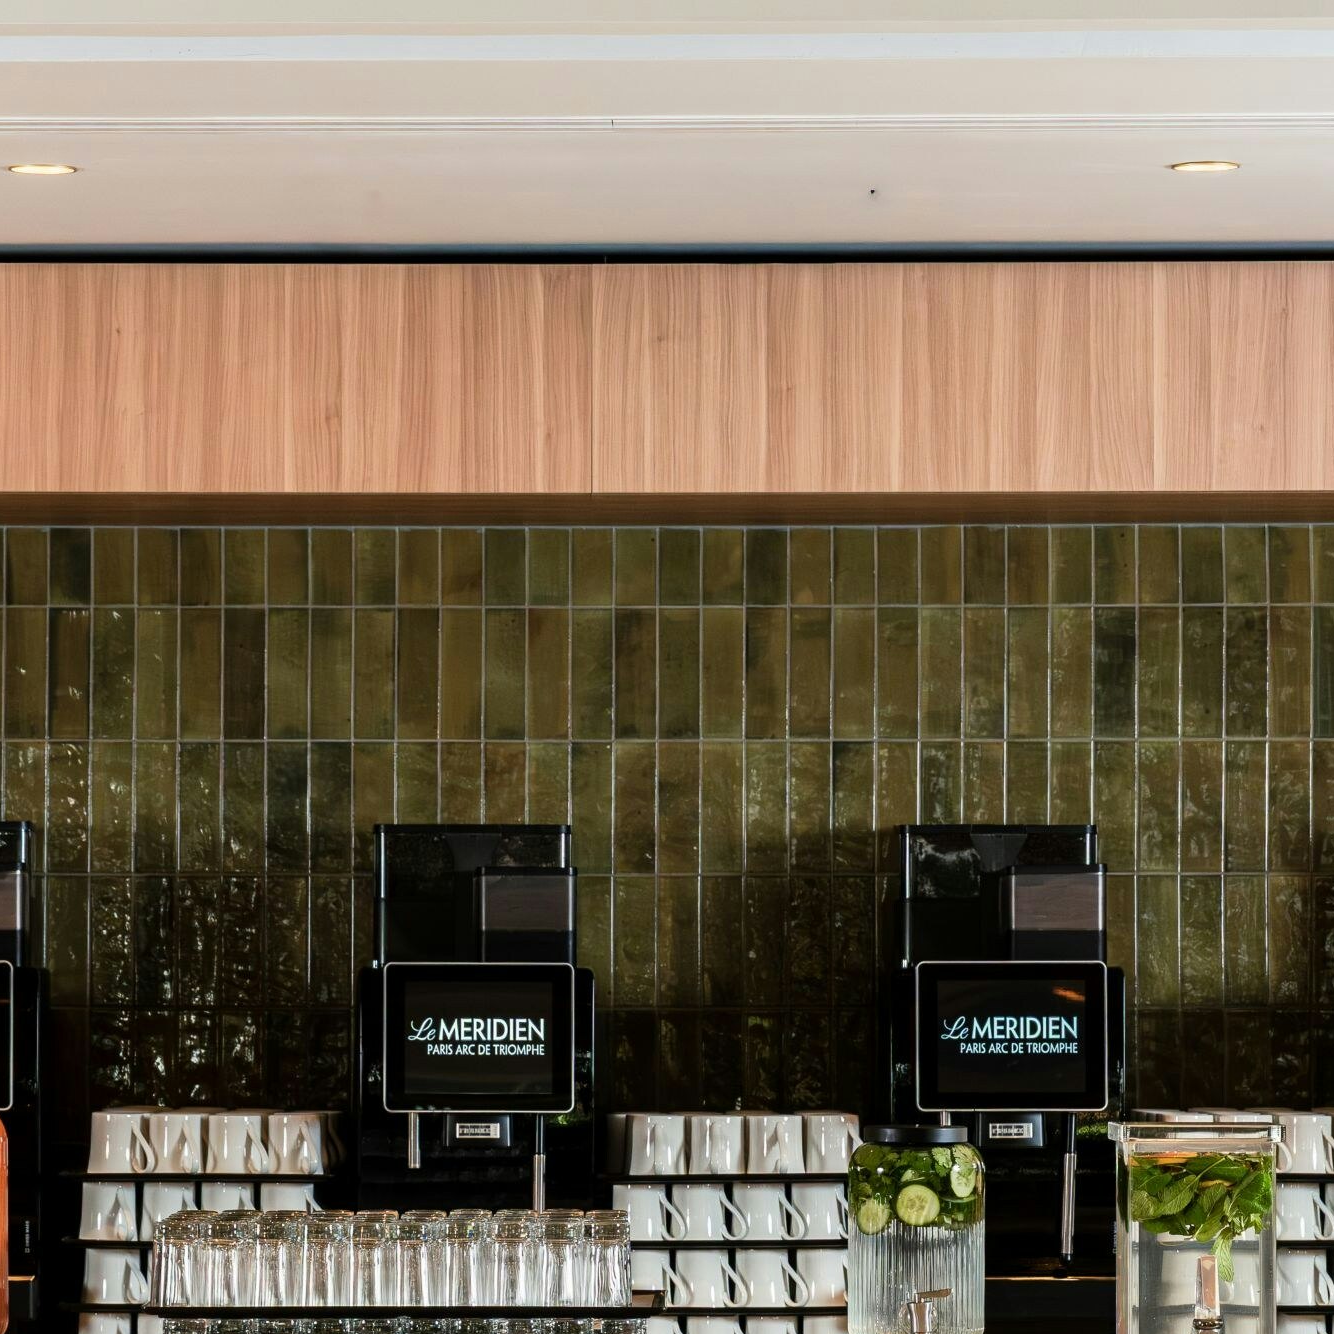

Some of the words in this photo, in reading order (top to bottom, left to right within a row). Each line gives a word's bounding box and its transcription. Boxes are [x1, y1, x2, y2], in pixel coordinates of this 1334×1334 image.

[408, 1018, 436, 1041] Le
[439, 1019, 544, 1040] MERIDIEN
[941, 1016, 968, 1039] Le
[972, 1017, 1077, 1038] MERIDIEN
[428, 1044, 453, 1055] PARIS
[455, 1044, 475, 1055] ARC
[478, 1044, 490, 1055] DE
[494, 1044, 544, 1055] TRIOMPHE
[961, 1043, 986, 1054] PARIS
[989, 1043, 1008, 1054] ARC
[1011, 1043, 1023, 1054] DE
[1027, 1043, 1078, 1054] TRIOMPHE
